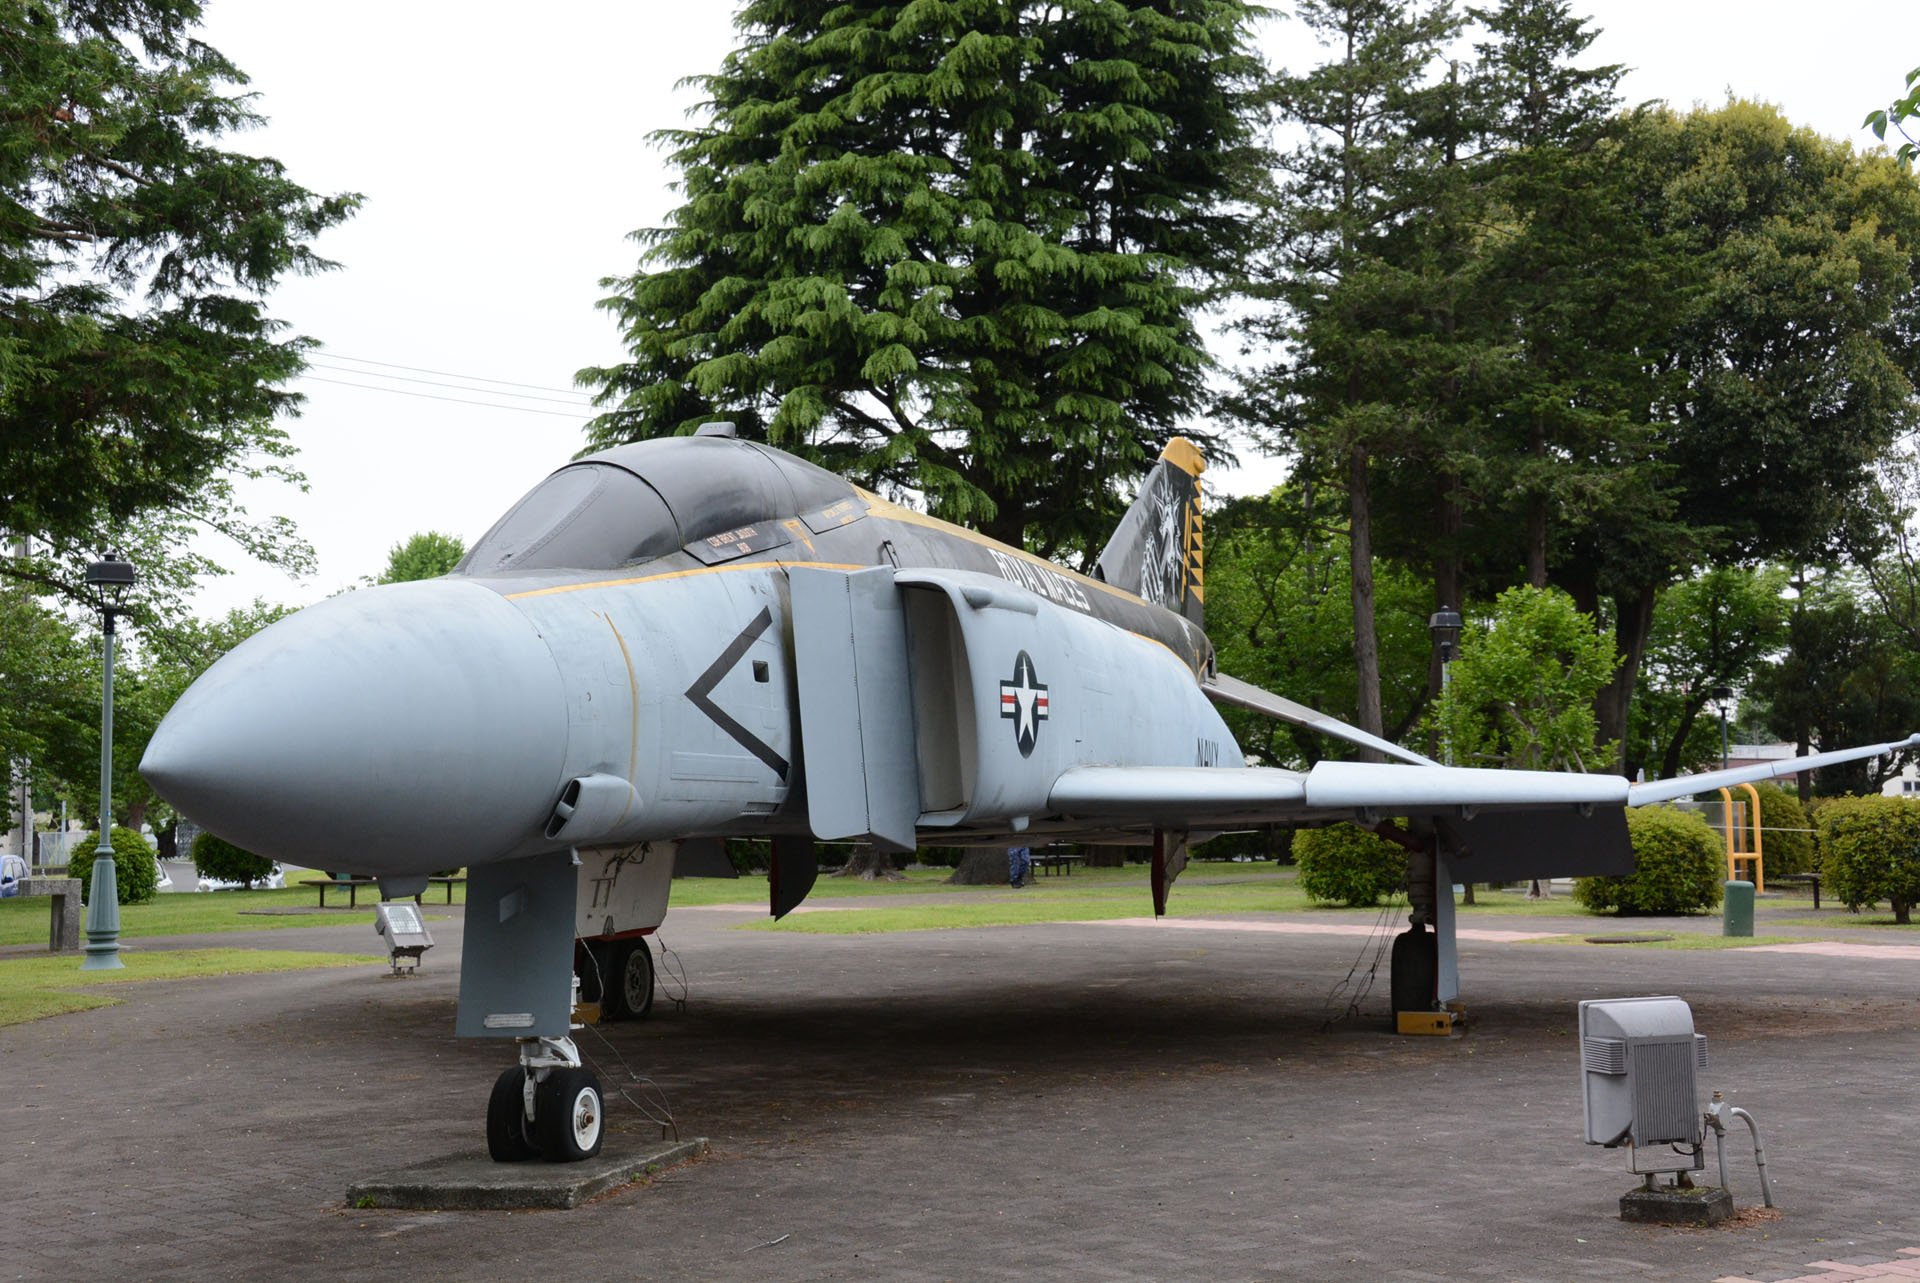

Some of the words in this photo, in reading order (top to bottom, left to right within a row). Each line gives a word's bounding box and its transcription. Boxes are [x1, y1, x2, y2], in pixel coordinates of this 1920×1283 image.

[987, 547, 1048, 597] ROYAL
[1033, 564, 1091, 611] MACES
[1197, 736, 1219, 768] NAVY
